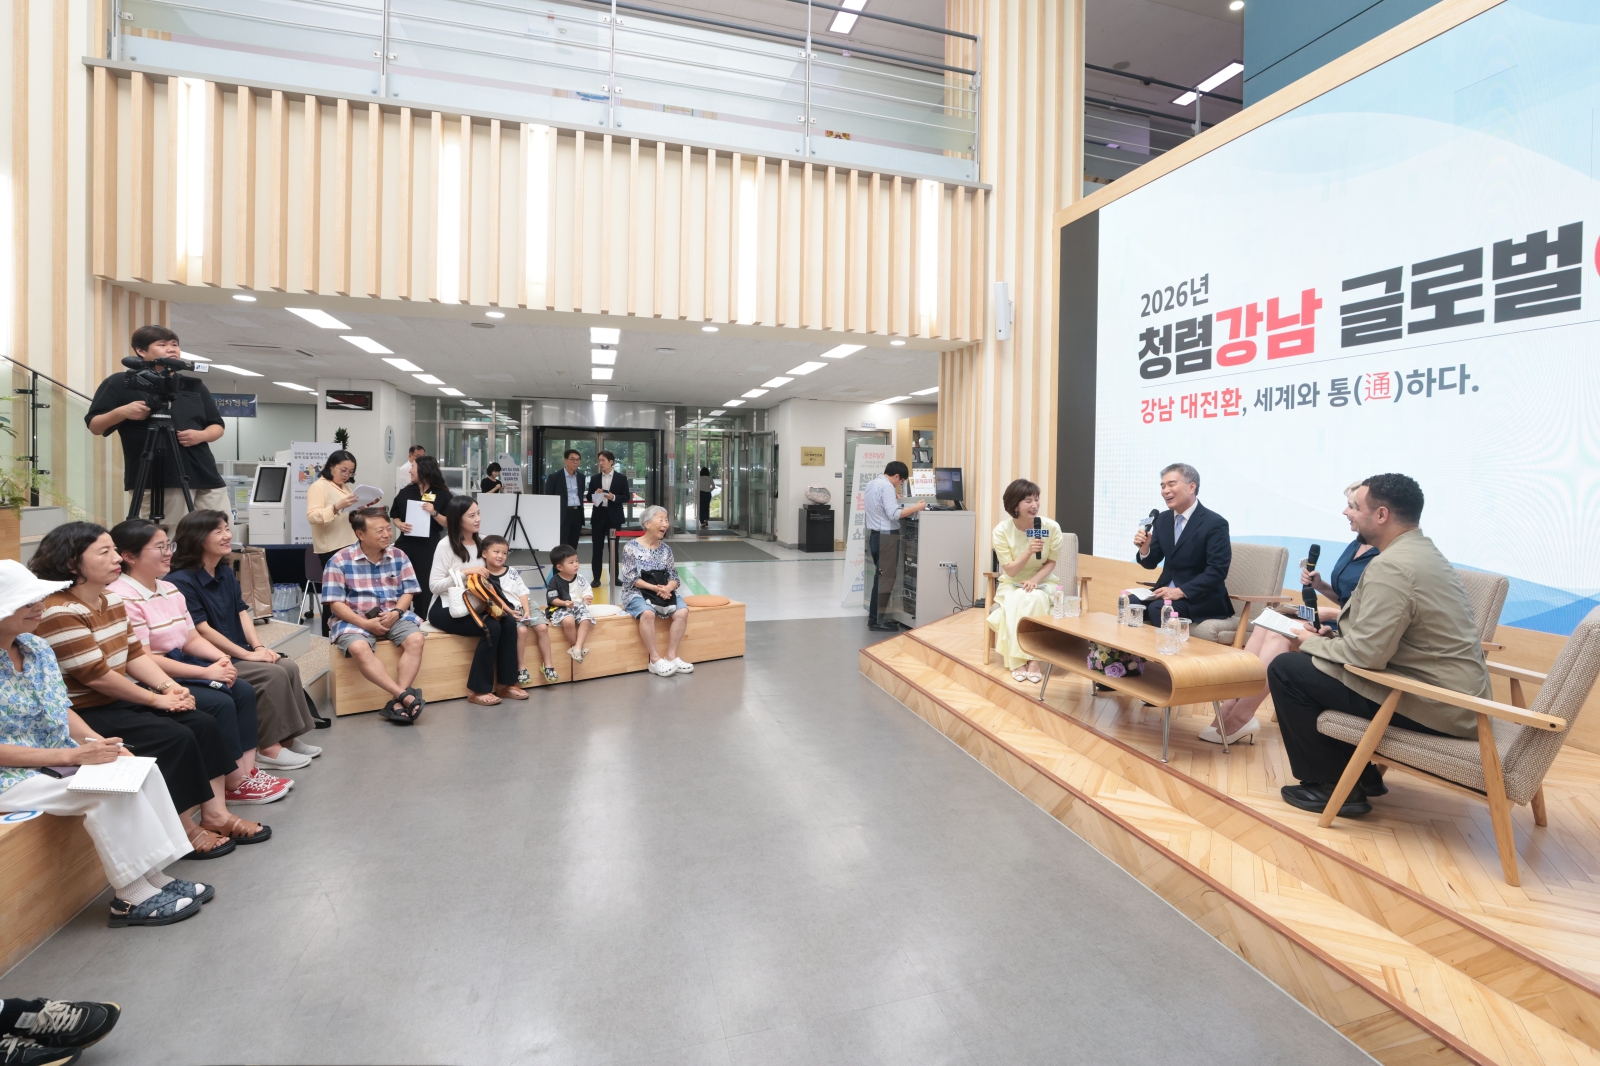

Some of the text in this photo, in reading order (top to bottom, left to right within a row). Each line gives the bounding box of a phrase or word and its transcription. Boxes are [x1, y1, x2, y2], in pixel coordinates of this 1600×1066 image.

[1138, 288, 1323, 380] 청렴강남
[1340, 221, 1584, 349] 글로벌
[1140, 273, 1209, 318] 2026년
[1141, 363, 1480, 424] 강남 대전환, 세계와 통(通)하다.
